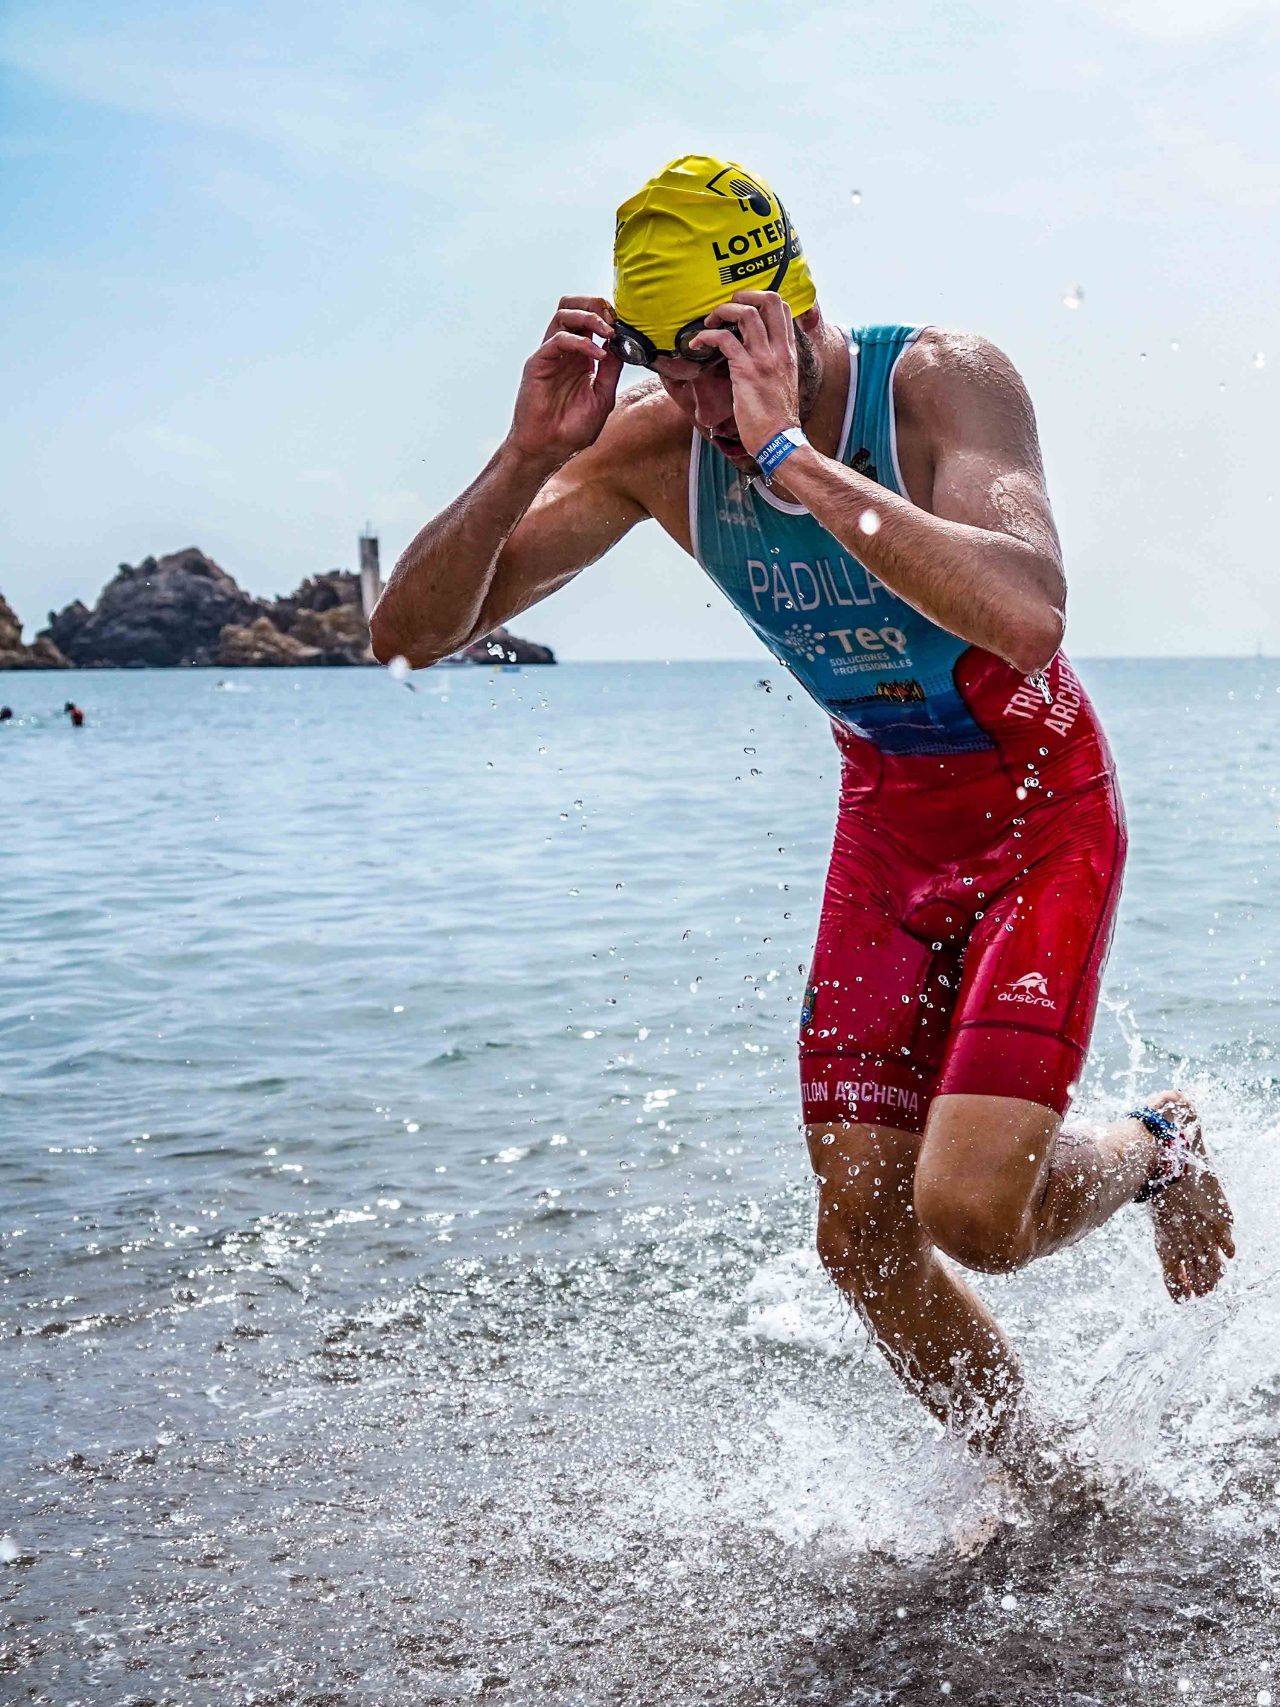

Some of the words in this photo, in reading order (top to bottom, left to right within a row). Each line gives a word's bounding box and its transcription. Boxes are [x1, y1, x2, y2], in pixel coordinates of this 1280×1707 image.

[737, 260, 764, 275] CON
[747, 556, 896, 612] PADILLA
[829, 652, 890, 667] SOLUCIONES
[832, 658, 913, 676] PROFESIONALES
[801, 1077, 829, 1102] TLÓN
[834, 1080, 919, 1112] ARCHENA
